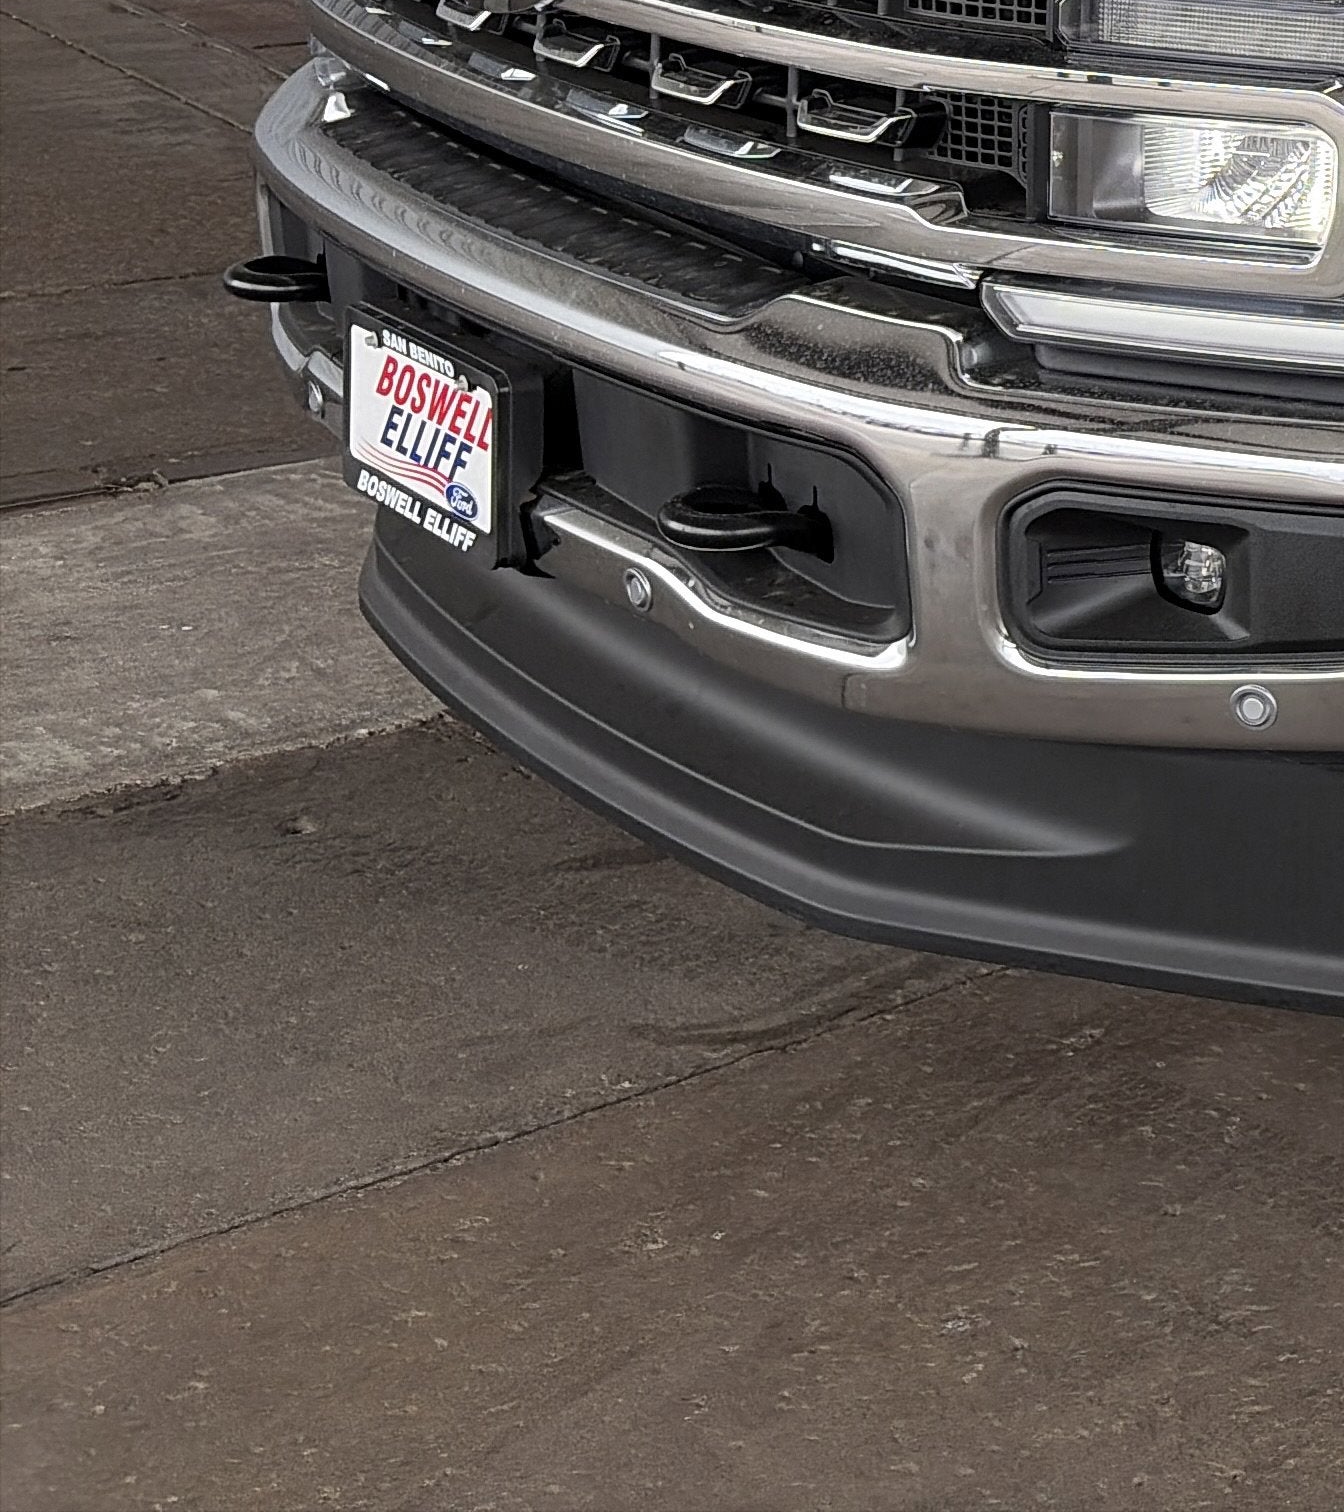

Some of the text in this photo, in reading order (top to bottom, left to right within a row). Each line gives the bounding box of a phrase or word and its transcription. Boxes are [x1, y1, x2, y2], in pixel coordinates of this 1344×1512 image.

[382, 329, 456, 378] SAN BENITO
[375, 354, 493, 452] BOSWELL
[380, 404, 474, 484] ELLIFF
[356, 468, 477, 552] BOSWELL ELLIFF
[450, 486, 475, 517] Ford
